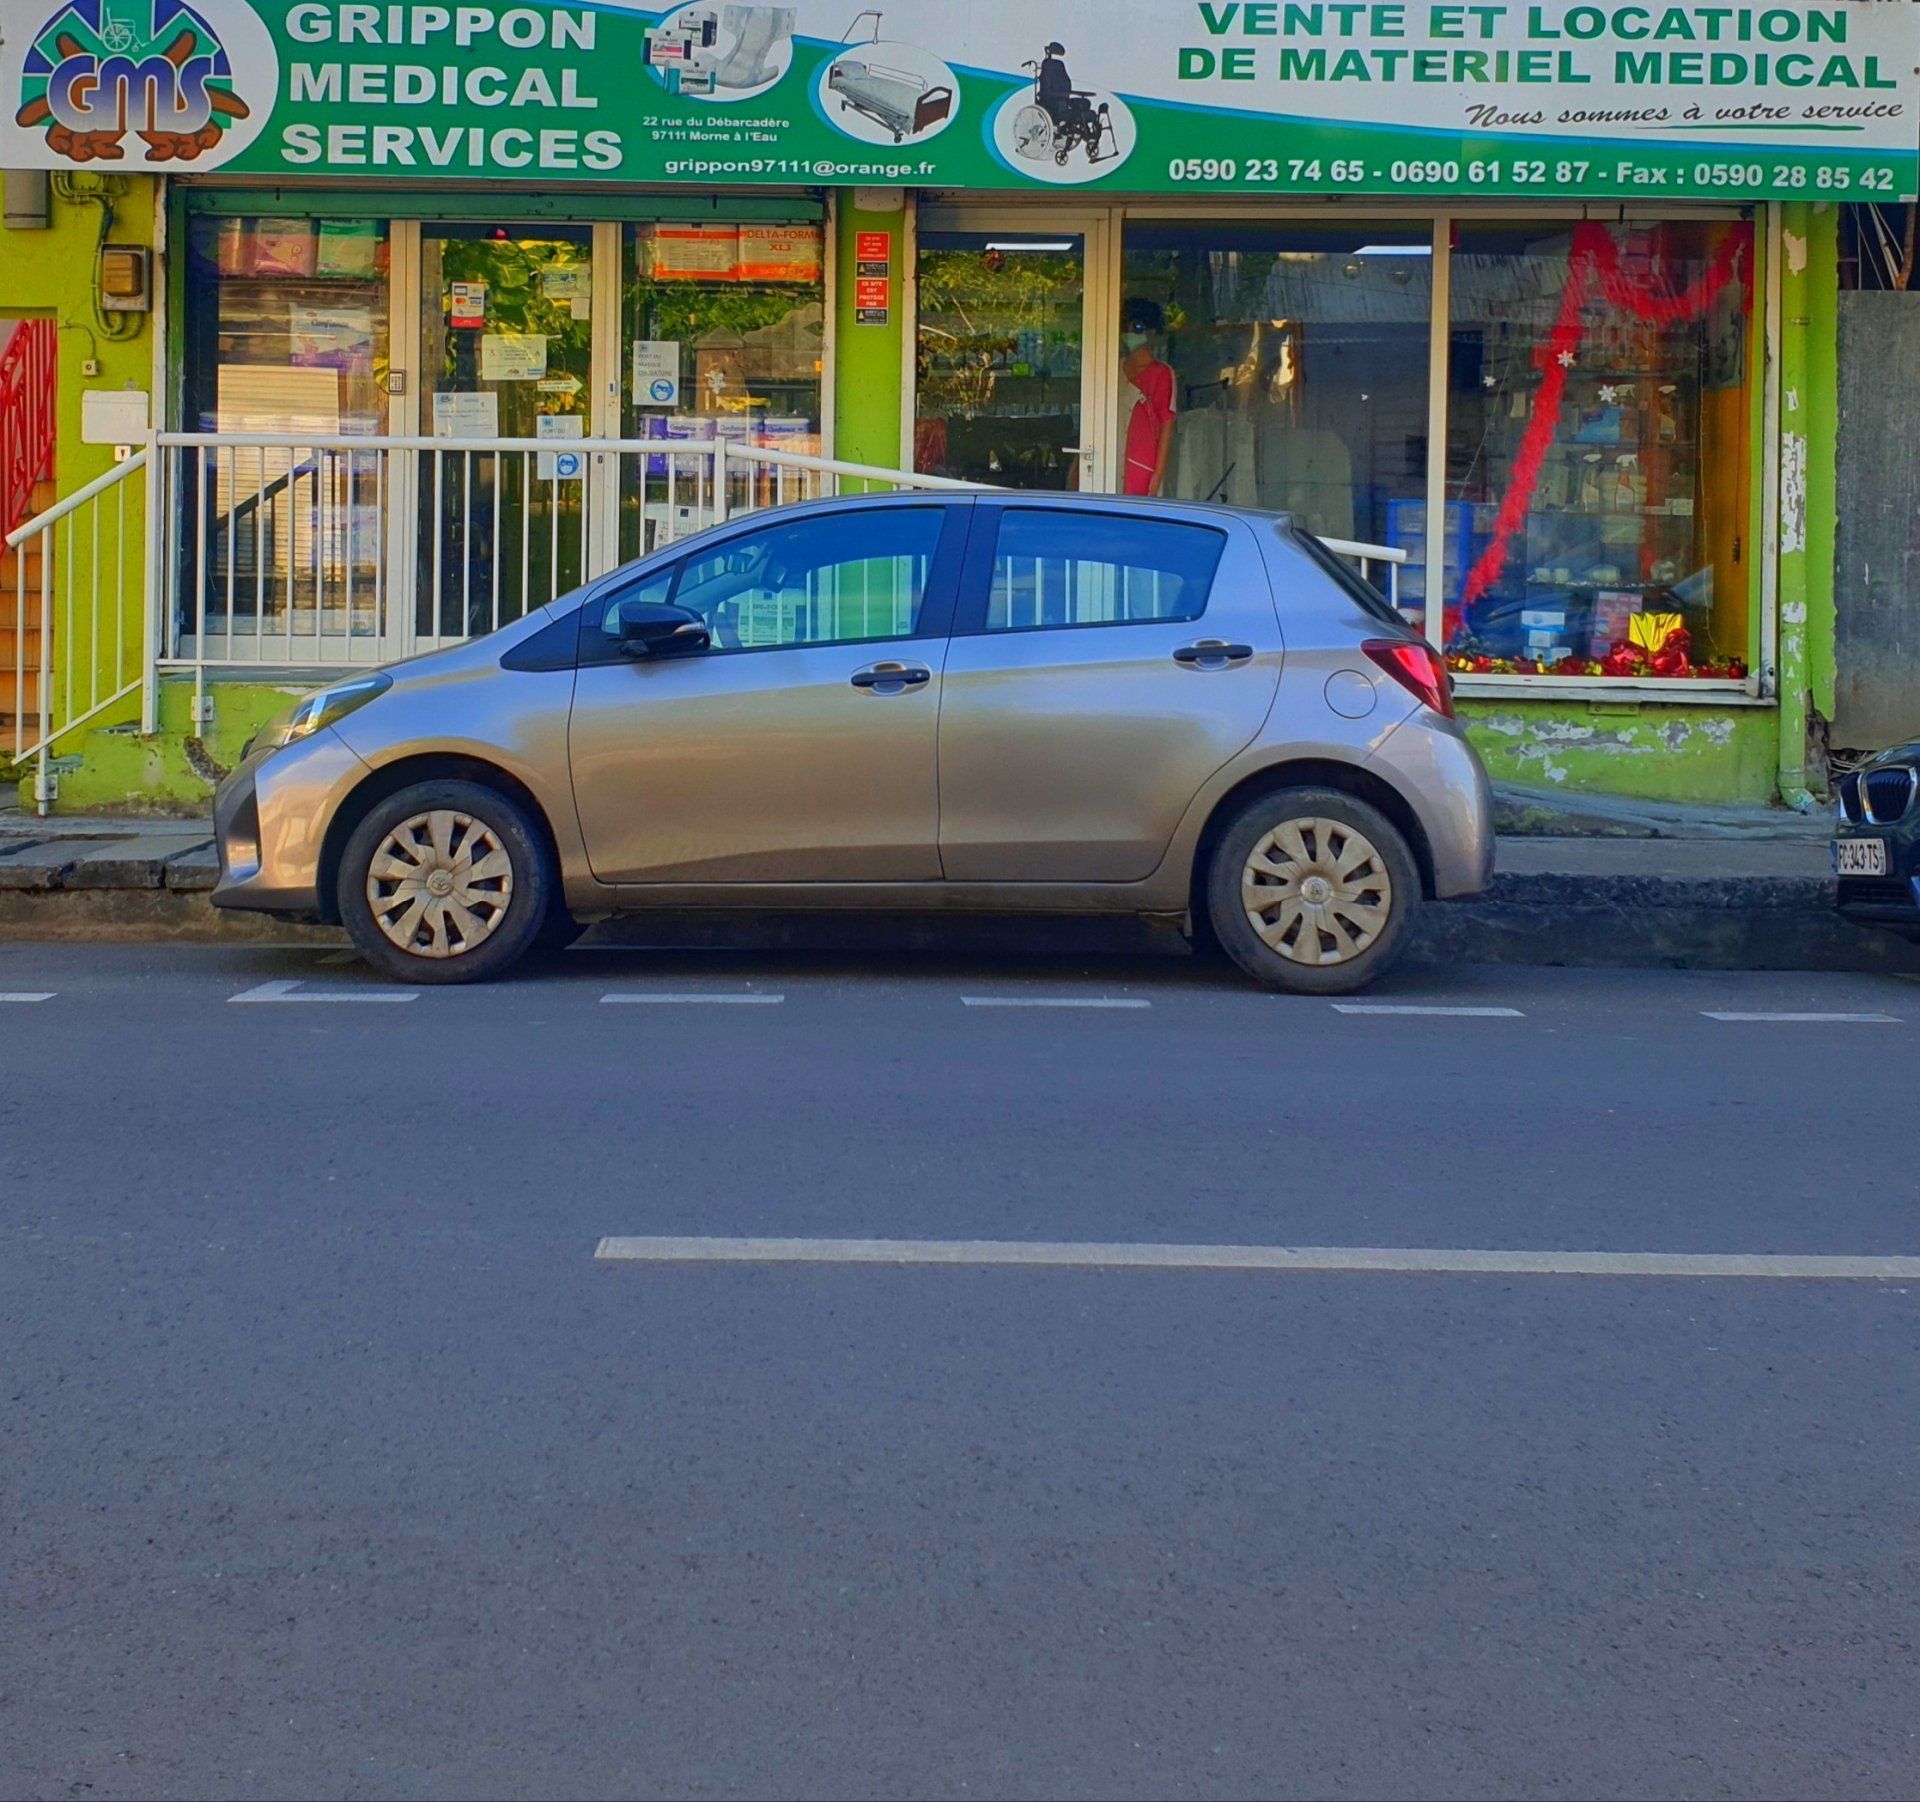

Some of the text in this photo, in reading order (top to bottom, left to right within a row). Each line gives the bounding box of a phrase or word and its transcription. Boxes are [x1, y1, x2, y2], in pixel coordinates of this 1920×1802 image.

[285, 4, 596, 50] GRIPPON
[1197, 2, 1847, 44] VENTE ET LOCATION
[289, 62, 599, 108] MEDICAL
[1177, 47, 1897, 90] DE MATERIEL MEDICAL
[643, 116, 790, 128] 22 rue du Débarcadère
[1464, 100, 1904, 127] Nous sommes à votre service
[280, 124, 623, 170] SERVICES
[652, 130, 777, 142] 97111 Morne à l'Eau
[665, 158, 936, 178] grippon97111@orange.fr
[1168, 158, 1236, 181] 0590
[1244, 159, 1279, 181] 23
[1288, 159, 1322, 182] 74
[1330, 159, 1364, 182] 65
[1390, 160, 1459, 183] 0690
[1468, 160, 1500, 183] 61
[1512, 161, 1546, 183] 52
[1555, 161, 1589, 183] 87
[1617, 162, 1667, 184] Fax
[1694, 164, 1763, 187] 0590
[1772, 165, 1807, 188] 28
[1816, 166, 1850, 189] 85
[1859, 168, 1894, 190] 42
